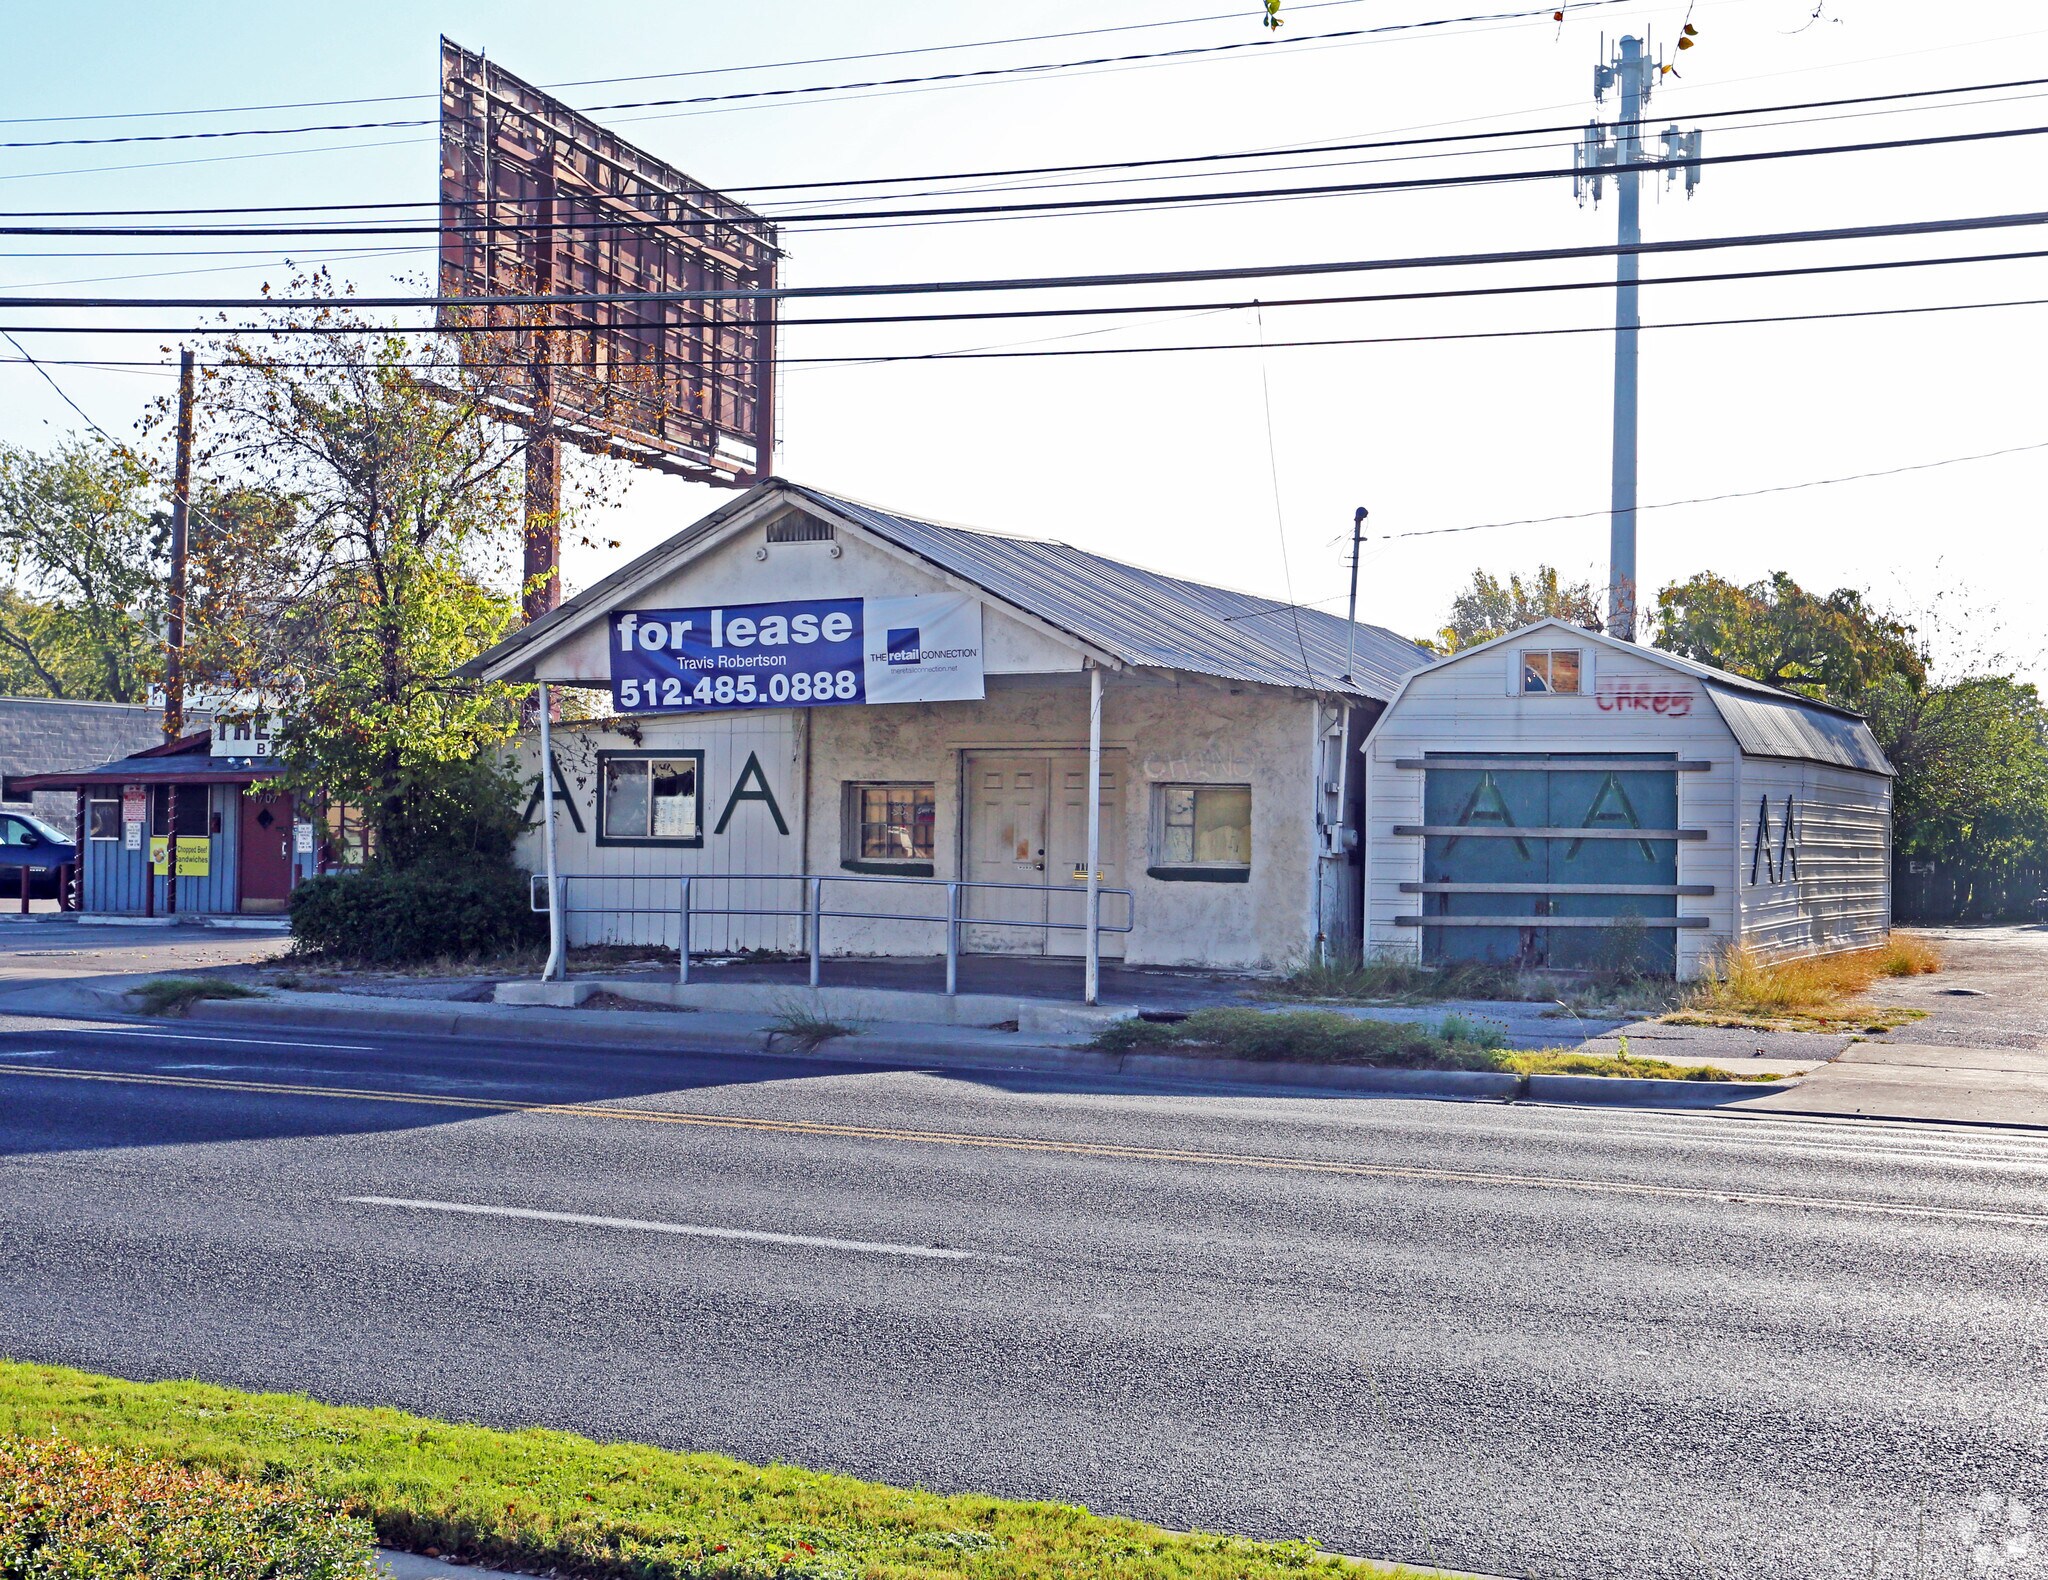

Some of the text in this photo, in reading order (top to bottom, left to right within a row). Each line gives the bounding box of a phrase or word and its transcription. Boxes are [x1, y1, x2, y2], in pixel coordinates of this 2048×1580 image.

[617, 609, 853, 651] for lease
[677, 654, 787, 670] Travis Robertson
[870, 649, 977, 662] THE retail CONNECTION
[620, 670, 857, 707] 512.485.0888
[713, 750, 789, 835] A
